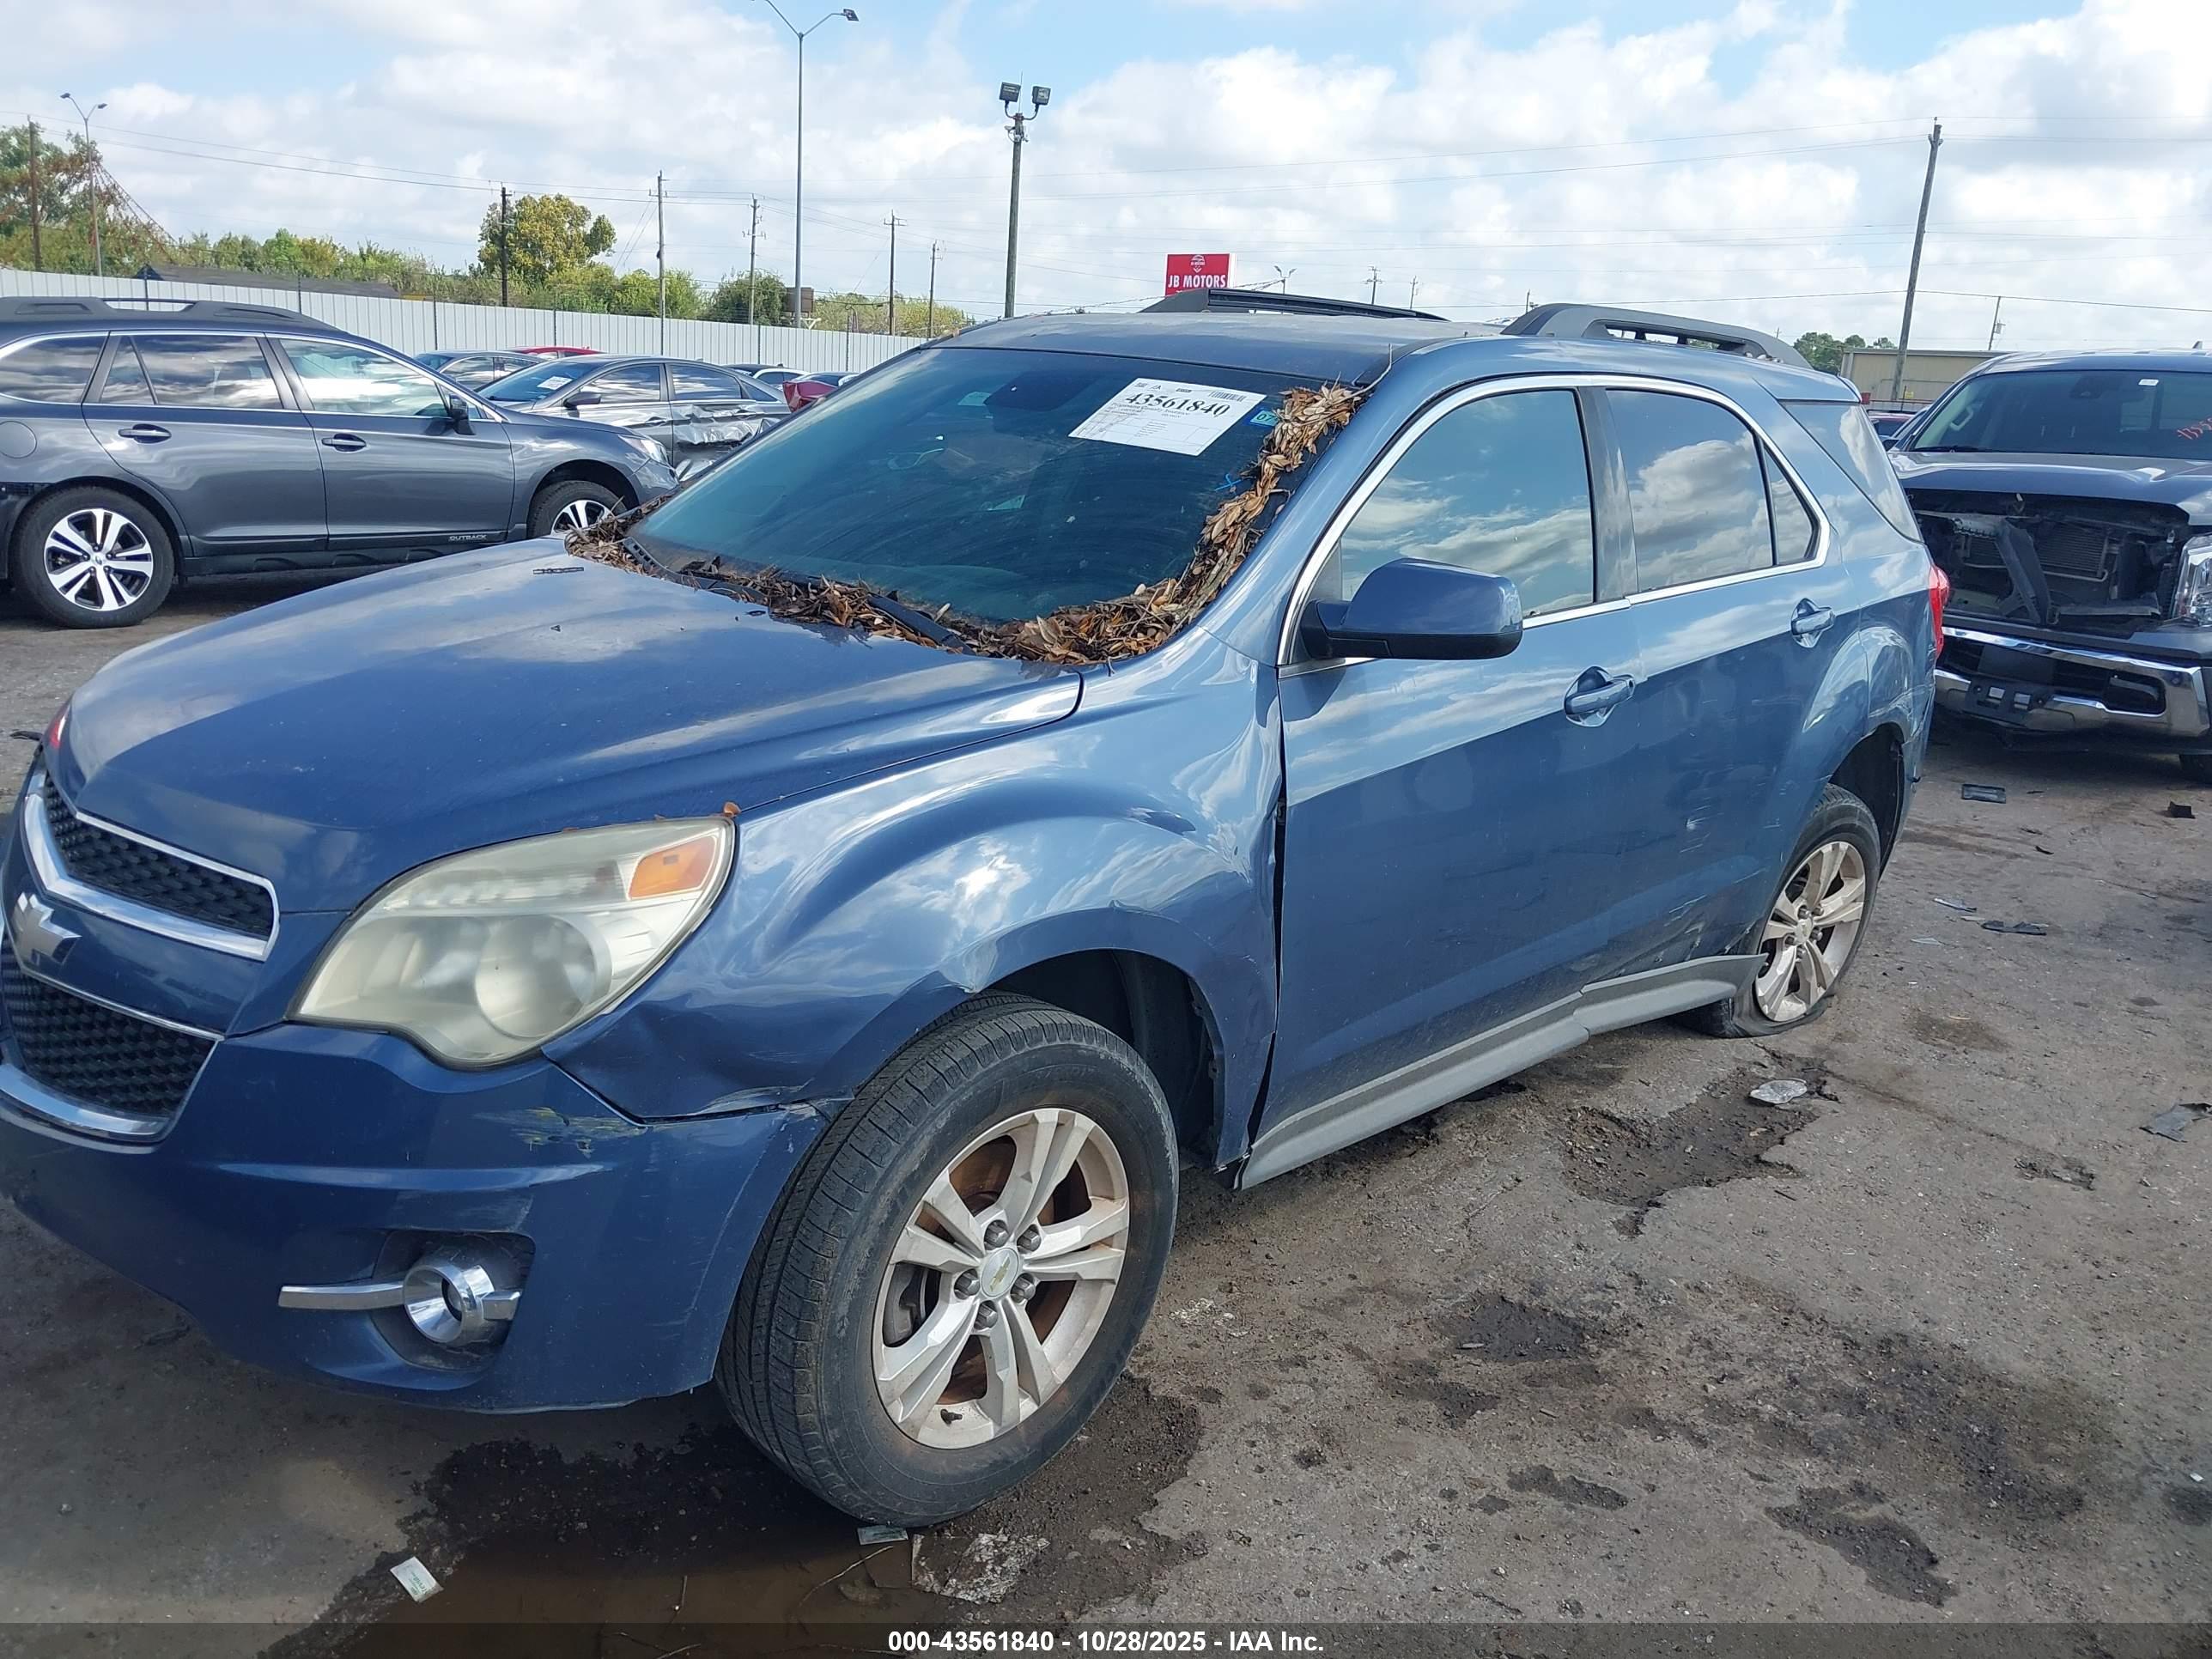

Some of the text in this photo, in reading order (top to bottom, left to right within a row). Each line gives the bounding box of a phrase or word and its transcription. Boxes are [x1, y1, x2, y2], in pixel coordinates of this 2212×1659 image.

[1168, 275, 1226, 288] JB MOTORS
[1125, 392, 1231, 416] 43561840
